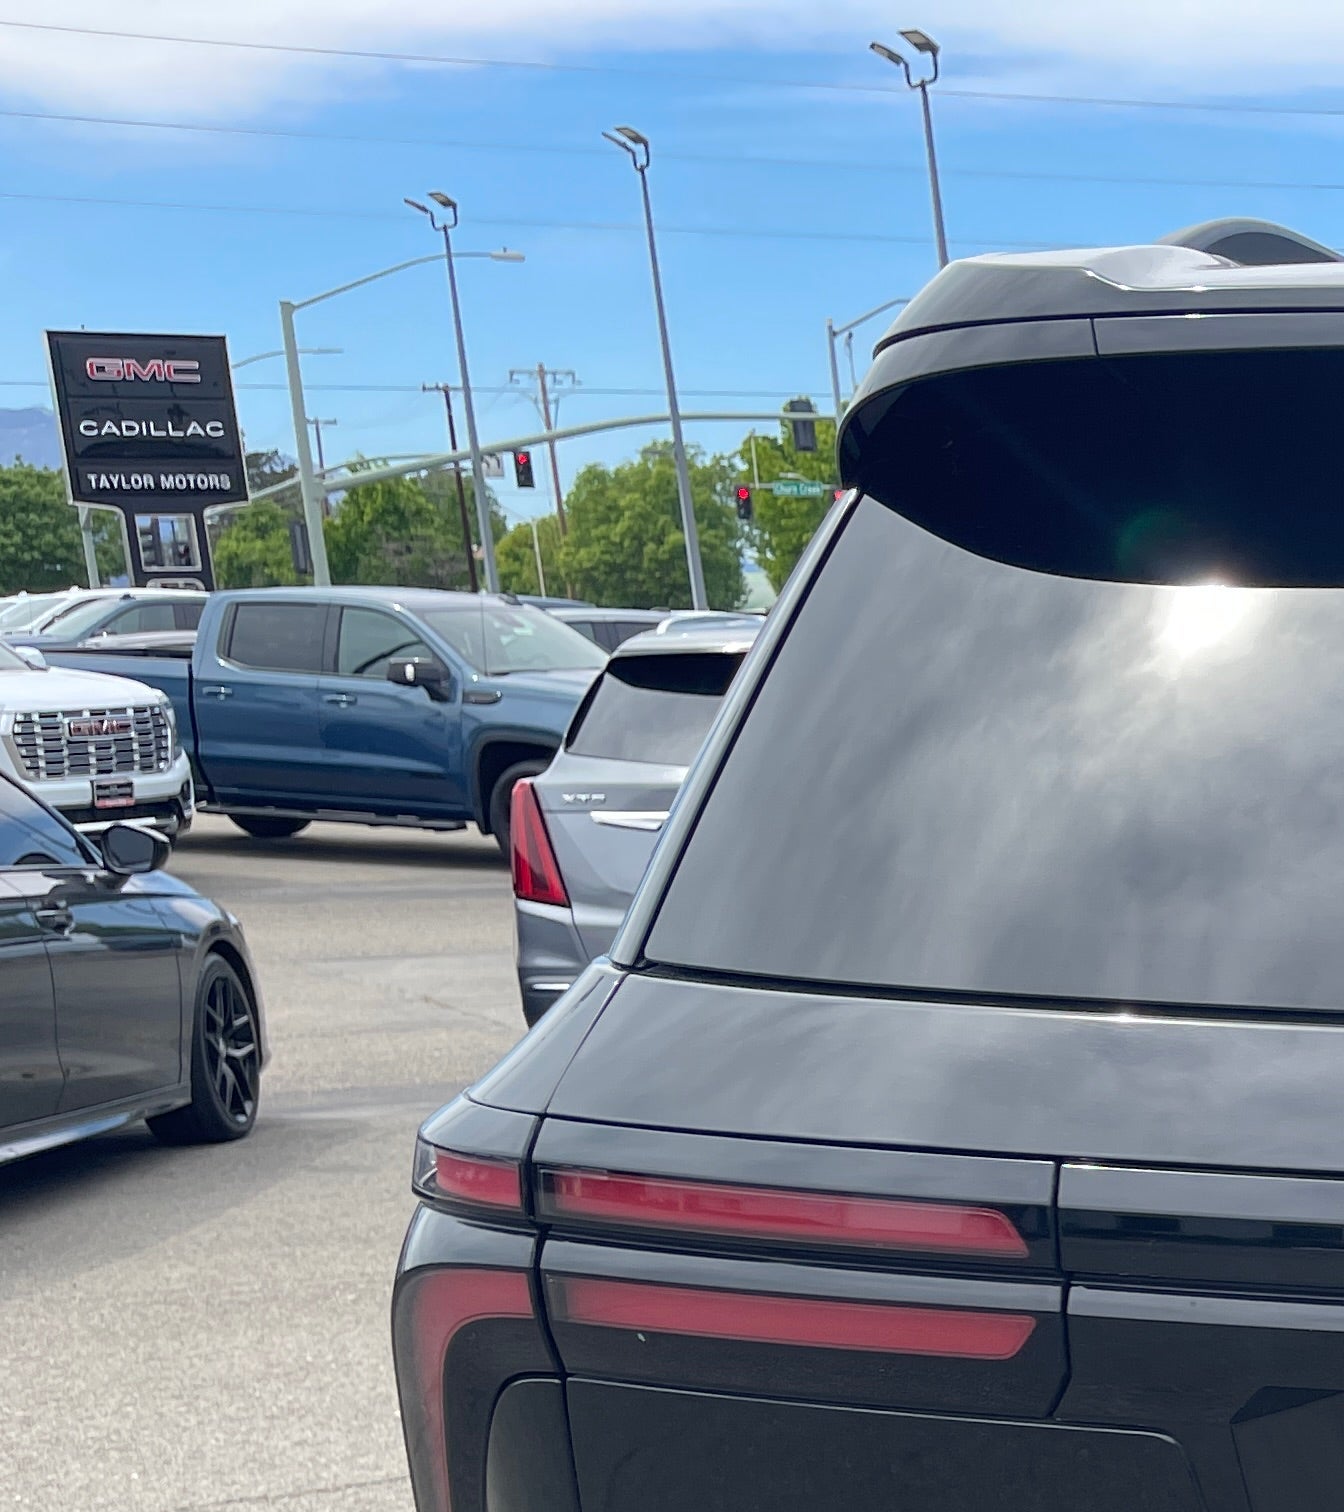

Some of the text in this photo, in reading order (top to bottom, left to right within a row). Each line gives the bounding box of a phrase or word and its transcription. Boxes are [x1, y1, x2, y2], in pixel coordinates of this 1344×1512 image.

[86, 358, 201, 383] GMC
[79, 419, 225, 438] CADILLAC
[87, 473, 231, 491] TAYLOR MOTORS
